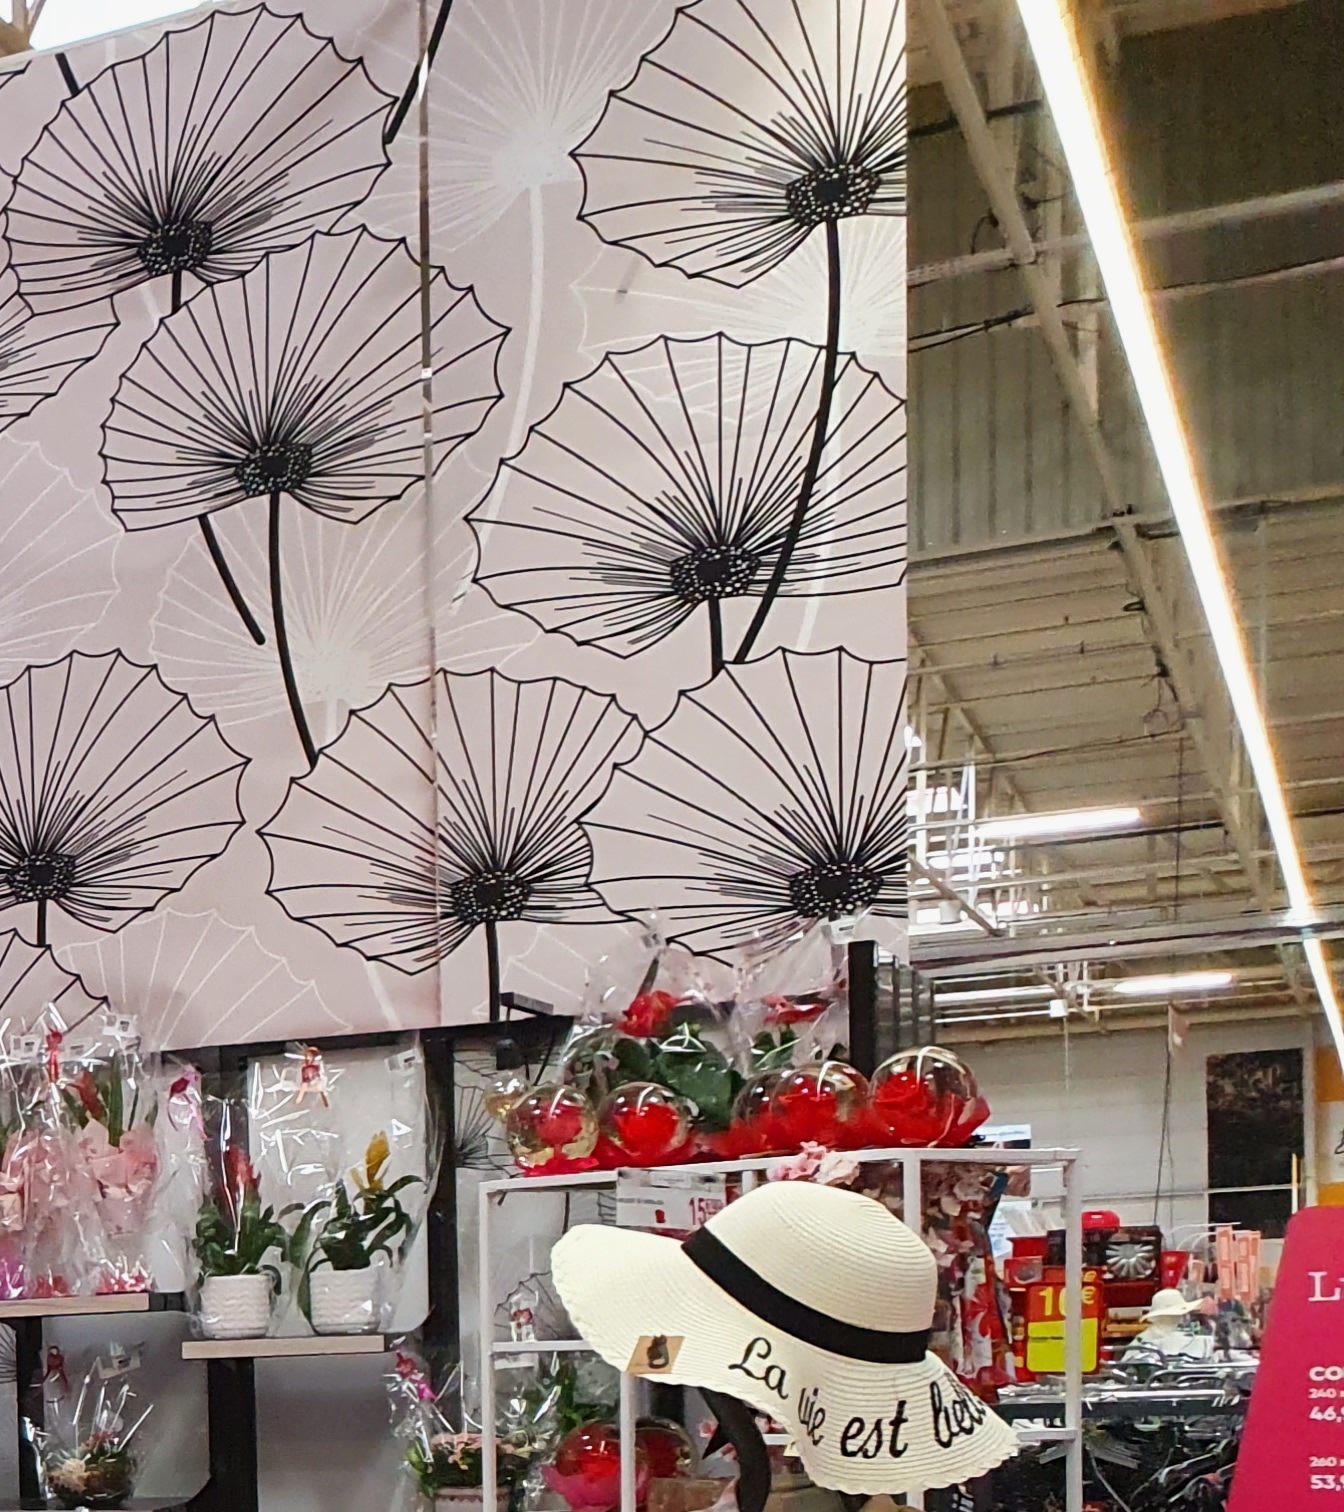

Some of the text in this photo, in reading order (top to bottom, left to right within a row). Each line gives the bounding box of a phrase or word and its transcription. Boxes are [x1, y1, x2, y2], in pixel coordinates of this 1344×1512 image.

[1308, 1271, 1344, 1302] L
[1309, 1366, 1344, 1381] CO
[728, 1337, 789, 1400] La
[798, 1387, 826, 1446] vie
[840, 1400, 908, 1459] est
